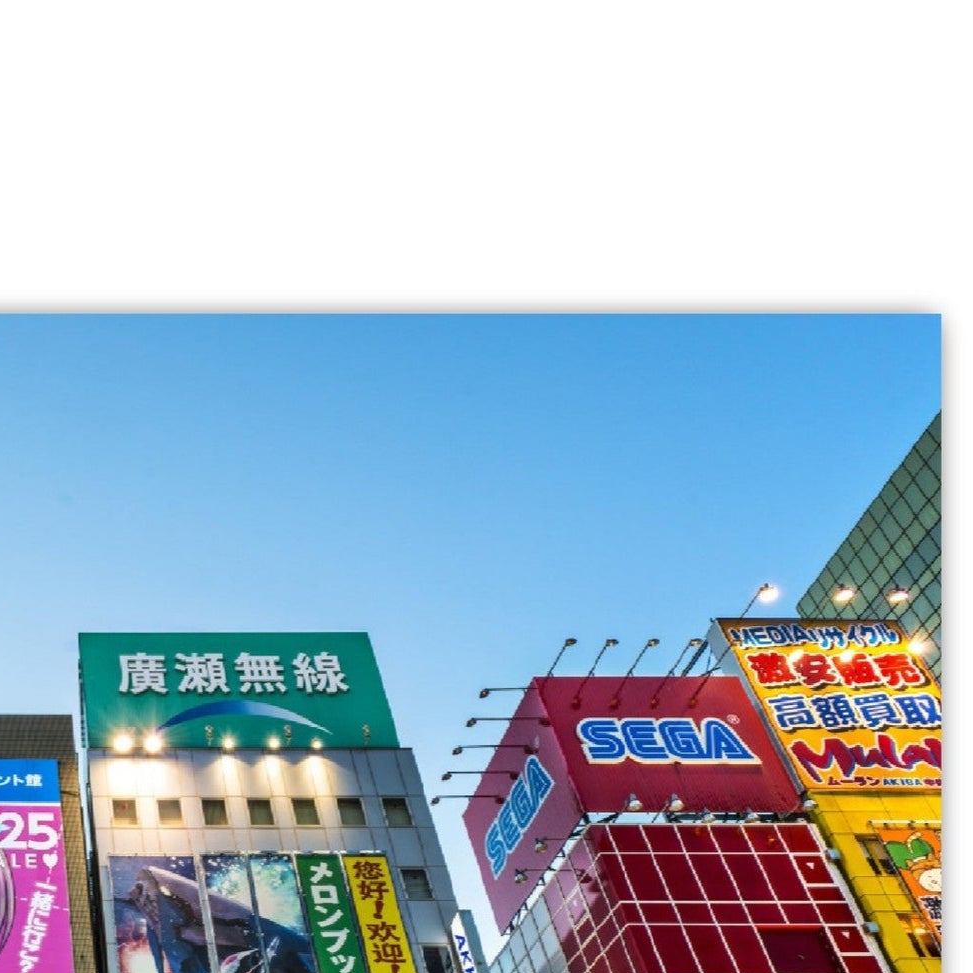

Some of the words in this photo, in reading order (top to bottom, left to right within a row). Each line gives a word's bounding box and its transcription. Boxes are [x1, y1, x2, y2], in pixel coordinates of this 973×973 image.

[118, 652, 349, 694] 廣瀬無線
[747, 652, 926, 687] 激安販売
[769, 694, 941, 729] 高額買取
[577, 718, 762, 765] SEGA
[485, 755, 555, 880] SEGA
